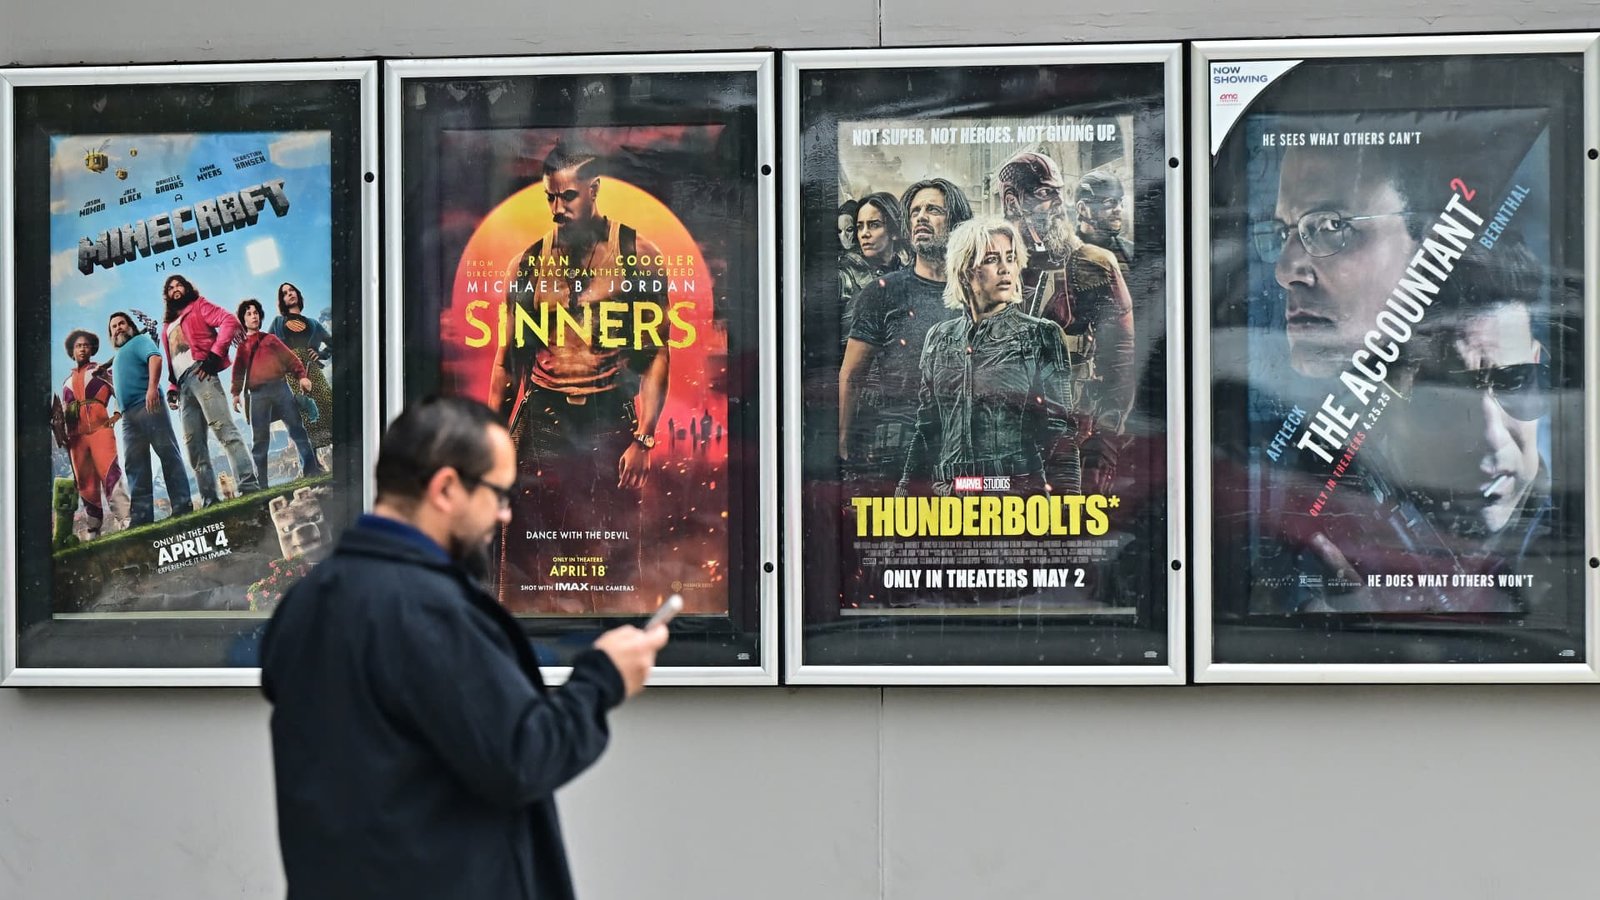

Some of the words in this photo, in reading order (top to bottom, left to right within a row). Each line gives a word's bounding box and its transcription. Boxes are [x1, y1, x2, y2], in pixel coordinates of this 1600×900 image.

[1213, 66, 1241, 75] NOW
[1213, 75, 1268, 84] SHOWING
[852, 129, 880, 146] NOT
[882, 129, 927, 145] SUPER.
[931, 127, 957, 144] NOT
[960, 127, 1014, 143] HEROES.
[1017, 126, 1042, 142] NOT
[1046, 125, 1094, 142] GIVING
[1098, 124, 1116, 141] UP.
[1262, 134, 1276, 146] HE
[1280, 133, 1305, 145] SEES
[1310, 133, 1339, 146] WHAT
[1343, 133, 1384, 145] OTHERS
[1389, 132, 1421, 145] CAN'T
[235, 155, 266, 170] HANSEN
[197, 168, 222, 181] MYERS
[155, 180, 184, 194] BROOKS
[84, 199, 101, 207] JASON
[119, 192, 142, 205] BLACK
[174, 194, 183, 202] A
[79, 203, 106, 217] MOMOA
[1478, 183, 1531, 251] BERNTHAL
[78, 178, 290, 275] MINECRAFT
[156, 243, 227, 272] MOVIE
[528, 255, 569, 266] RYAN
[616, 255, 694, 266] COOGLER
[534, 269, 569, 277] BLACK
[575, 268, 627, 277] PANTHER
[657, 268, 694, 277] CREED
[467, 280, 560, 293] MICHAEL
[575, 280, 592, 293] B.
[608, 280, 695, 293] JORDAN
[465, 300, 697, 350] SINNERS
[1297, 393, 1360, 464] THE
[1339, 193, 1484, 405] ACCOUNTANT
[1265, 404, 1307, 462] AFFLECK
[1309, 491, 1329, 517] ONLY
[1324, 478, 1337, 492] IN
[1332, 431, 1367, 478] THEATERS
[1363, 392, 1391, 430] 4.25.25
[956, 477, 982, 490] MARVEL
[983, 477, 1010, 490] STUDIOS
[153, 536, 175, 549] ONLY
[176, 533, 186, 543] IN
[187, 522, 225, 539] THEATERS
[526, 531, 557, 539] DANCE
[560, 531, 582, 539] WITH
[585, 531, 601, 539] THE
[604, 531, 629, 539] DEVIL
[158, 535, 212, 566] APRIL
[215, 530, 228, 547] 4
[157, 560, 193, 574] EXPERIENCE
[208, 547, 232, 559] IMAX
[549, 565, 587, 577] APRIL
[592, 565, 606, 577] 18
[884, 570, 922, 588] ONLY
[926, 570, 942, 588] IN
[947, 569, 1028, 588] THEATERS
[1032, 569, 1069, 588] MAY
[1074, 568, 1085, 588] 2
[555, 583, 589, 591] IMAX
[1367, 574, 1381, 587] HE
[1385, 574, 1414, 587] DOES
[1418, 574, 1447, 588] WHAT
[1452, 574, 1494, 587] OTHERS
[1498, 574, 1534, 587] WON'T
